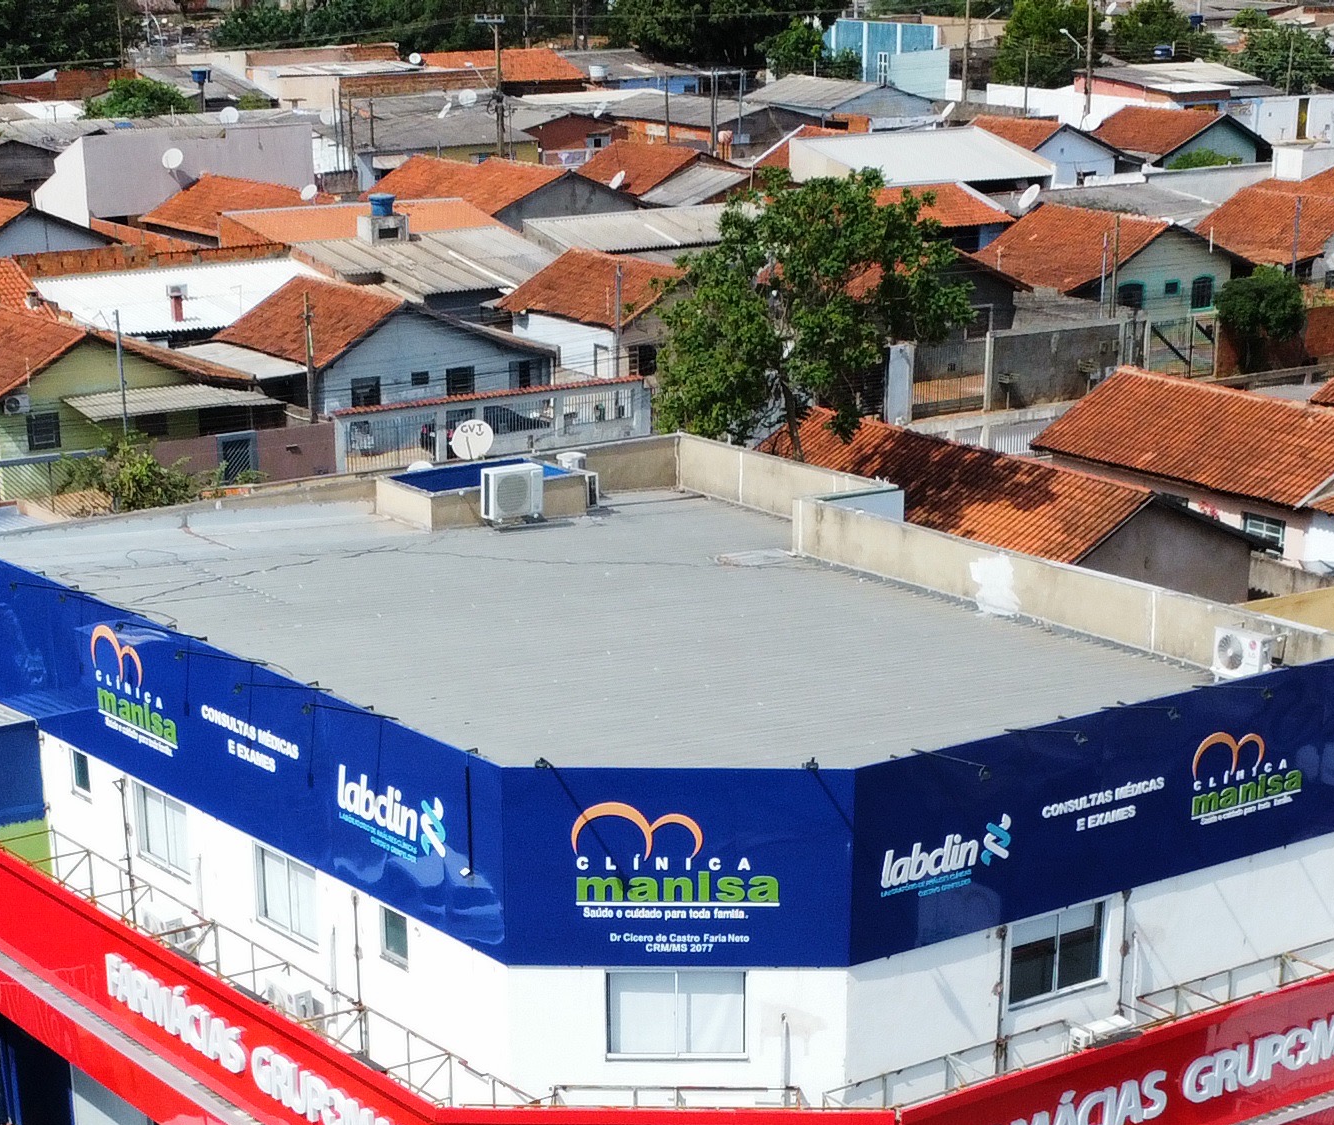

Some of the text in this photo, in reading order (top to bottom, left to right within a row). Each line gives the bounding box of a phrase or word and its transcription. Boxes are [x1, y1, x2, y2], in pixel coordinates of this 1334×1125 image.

[97, 687, 178, 745] manisa
[201, 704, 257, 741] CONSULTAS
[257, 729, 299, 760] MÉDICAS
[228, 738, 276, 773] E EXAMES
[1041, 776, 1165, 819] CONSULTAS MÉDICAS
[1192, 769, 1302, 816] manisa
[1076, 804, 1136, 831] E EXAMES
[576, 854, 751, 871] CLÍNICA
[576, 871, 779, 902] manisa
[583, 907, 614, 919] Saúde
[624, 907, 662, 919] cuidado
[665, 909, 686, 921] para
[689, 908, 711, 919] toda
[609, 933, 622, 942] Dr
[655, 933, 667, 942] de
[669, 933, 701, 943] Castro
[703, 933, 727, 942] Faria
[728, 933, 750, 943] Neto
[645, 943, 714, 953] CRM/MS 2077
[105, 953, 249, 1074] FARMÁCIAS
